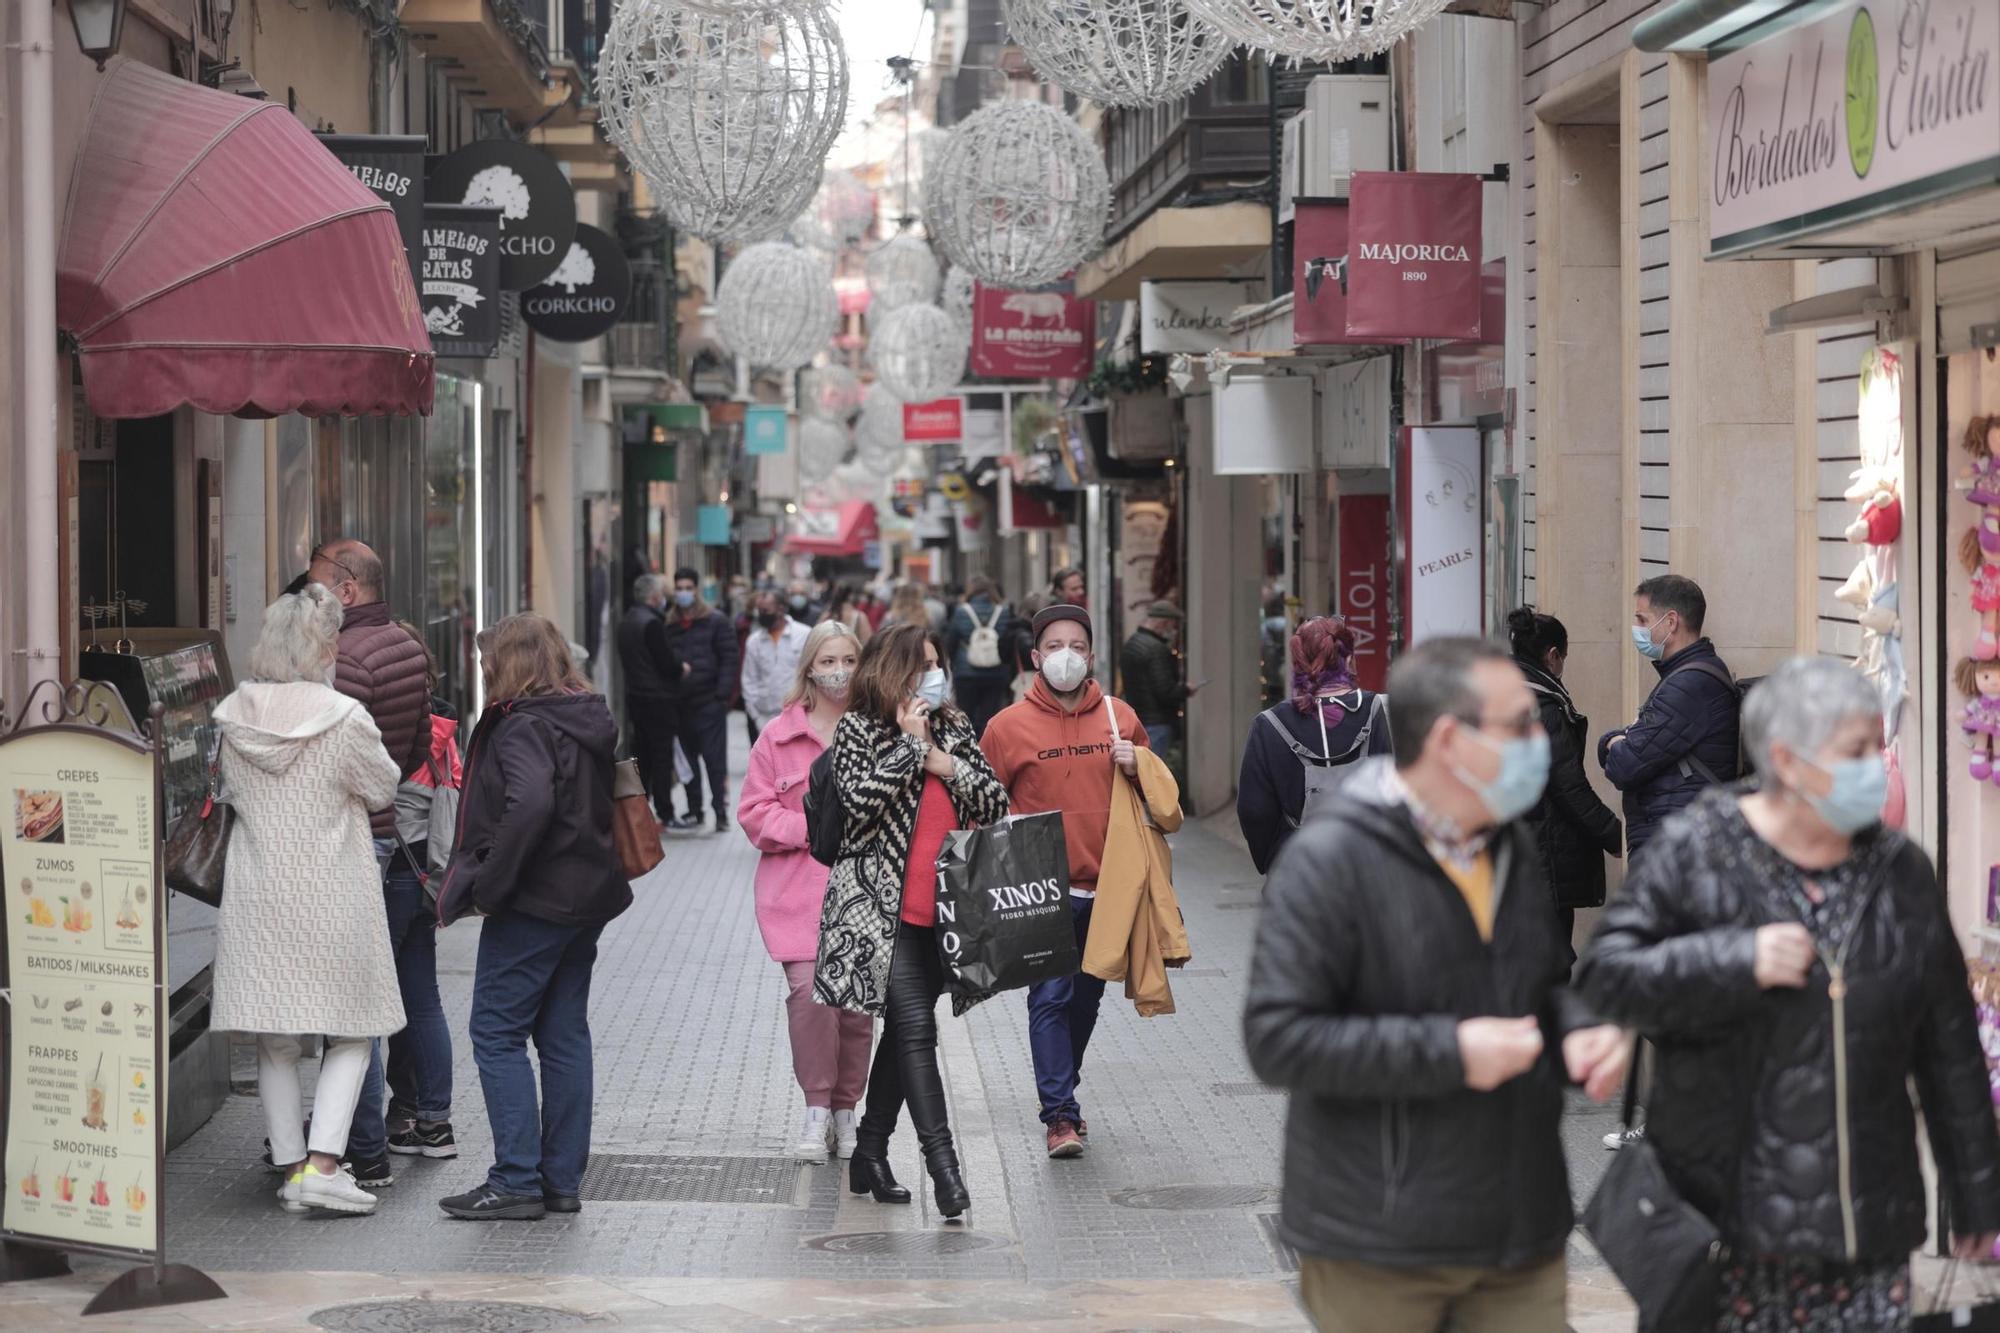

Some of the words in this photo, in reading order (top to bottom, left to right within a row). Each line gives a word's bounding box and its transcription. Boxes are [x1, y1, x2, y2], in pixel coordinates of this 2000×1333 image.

[1714, 39, 1839, 206] Bordados
[428, 247, 447, 260] DE
[1359, 243, 1470, 265] MAJORICA
[422, 258, 473, 280] RATAS
[1402, 271, 1427, 281] 1890
[527, 297, 616, 315] CORKCHO
[1152, 306, 1229, 331] ulanka
[984, 327, 1004, 341] LA
[1418, 548, 1474, 577] PEARLS
[57, 769, 99, 784] CREPES
[36, 858, 75, 872] ZUMOS
[987, 878, 1062, 912] XINO'S
[1000, 909, 1025, 921] PEDRO
[1026, 904, 1061, 917] MESQUIDA
[27, 956, 72, 973] BATIDOS
[80, 959, 149, 979] MILKSHAKES
[28, 1045, 79, 1062] FRAPPES
[52, 1139, 118, 1159] SMOOTHIES
